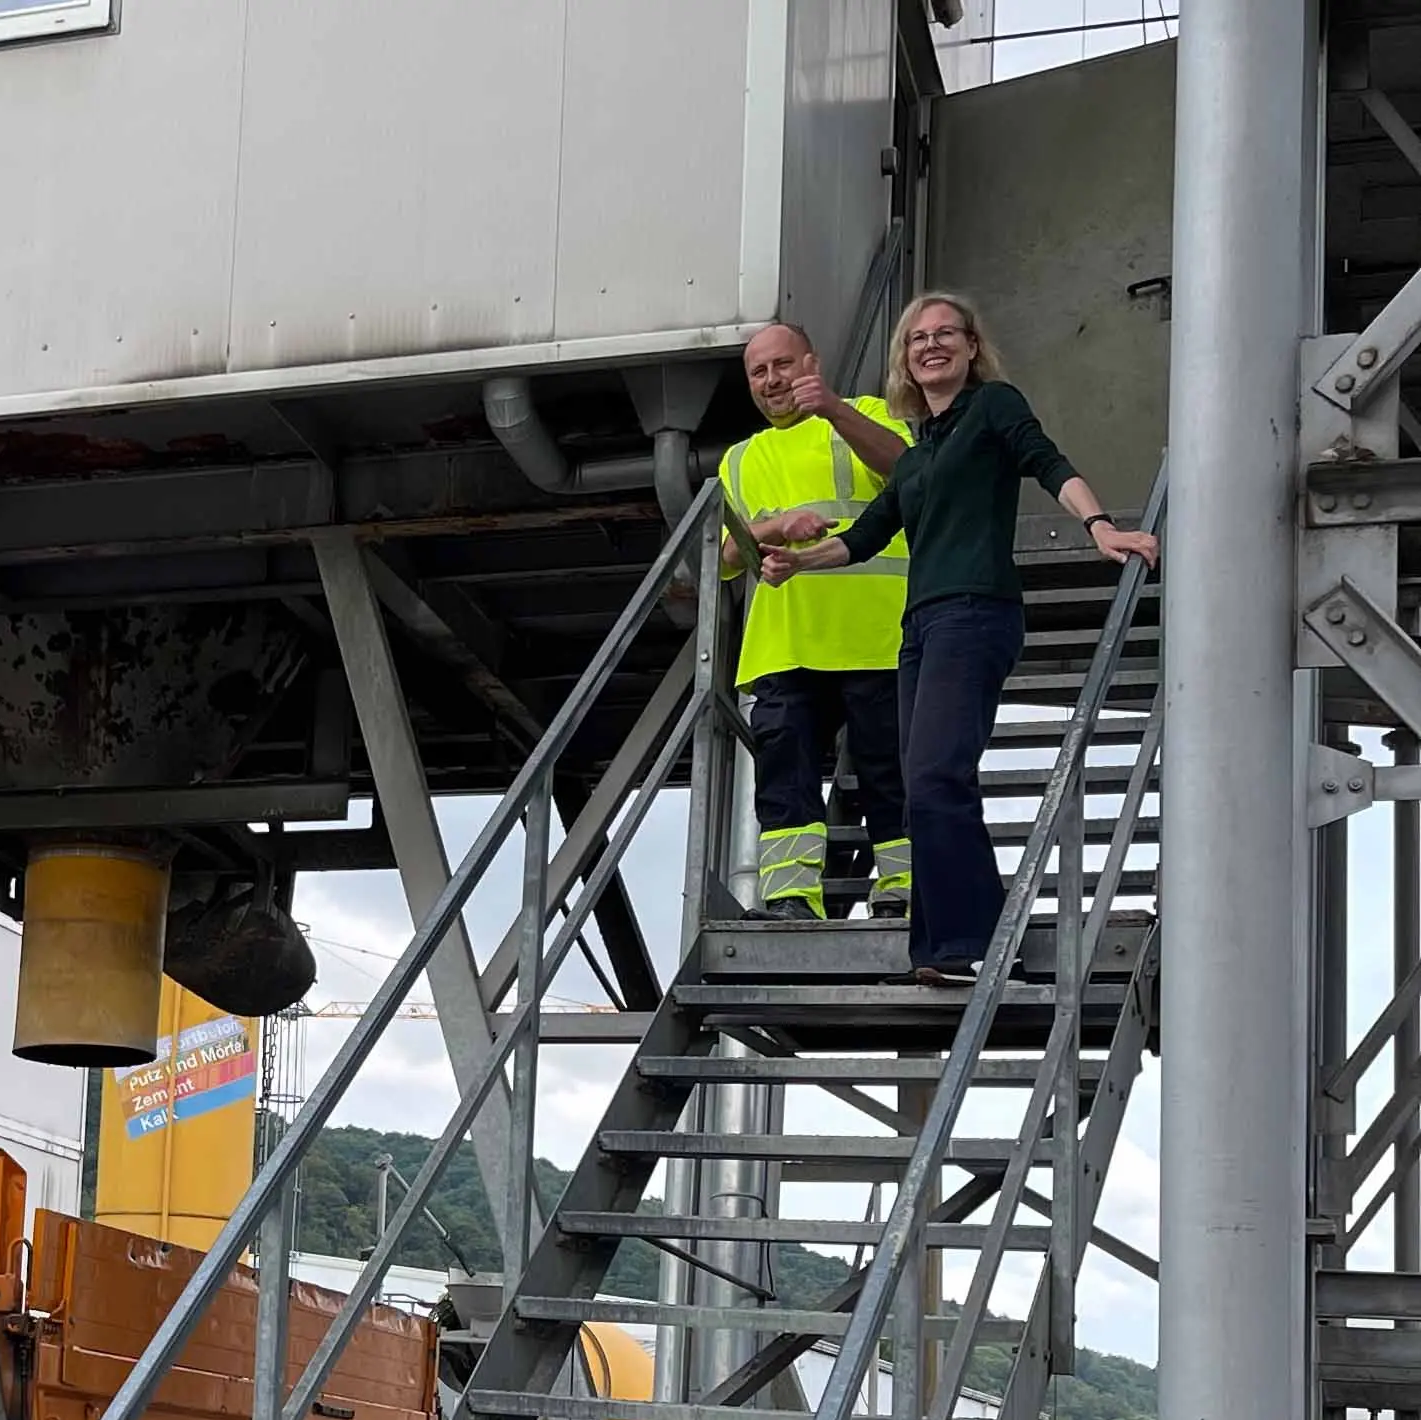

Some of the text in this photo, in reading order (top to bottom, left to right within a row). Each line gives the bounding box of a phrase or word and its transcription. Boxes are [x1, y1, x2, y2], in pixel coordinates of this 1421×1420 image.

[129, 1068, 164, 1092] Putz
[200, 1039, 245, 1065] Mörtel
[132, 1078, 196, 1112] Zemnt
